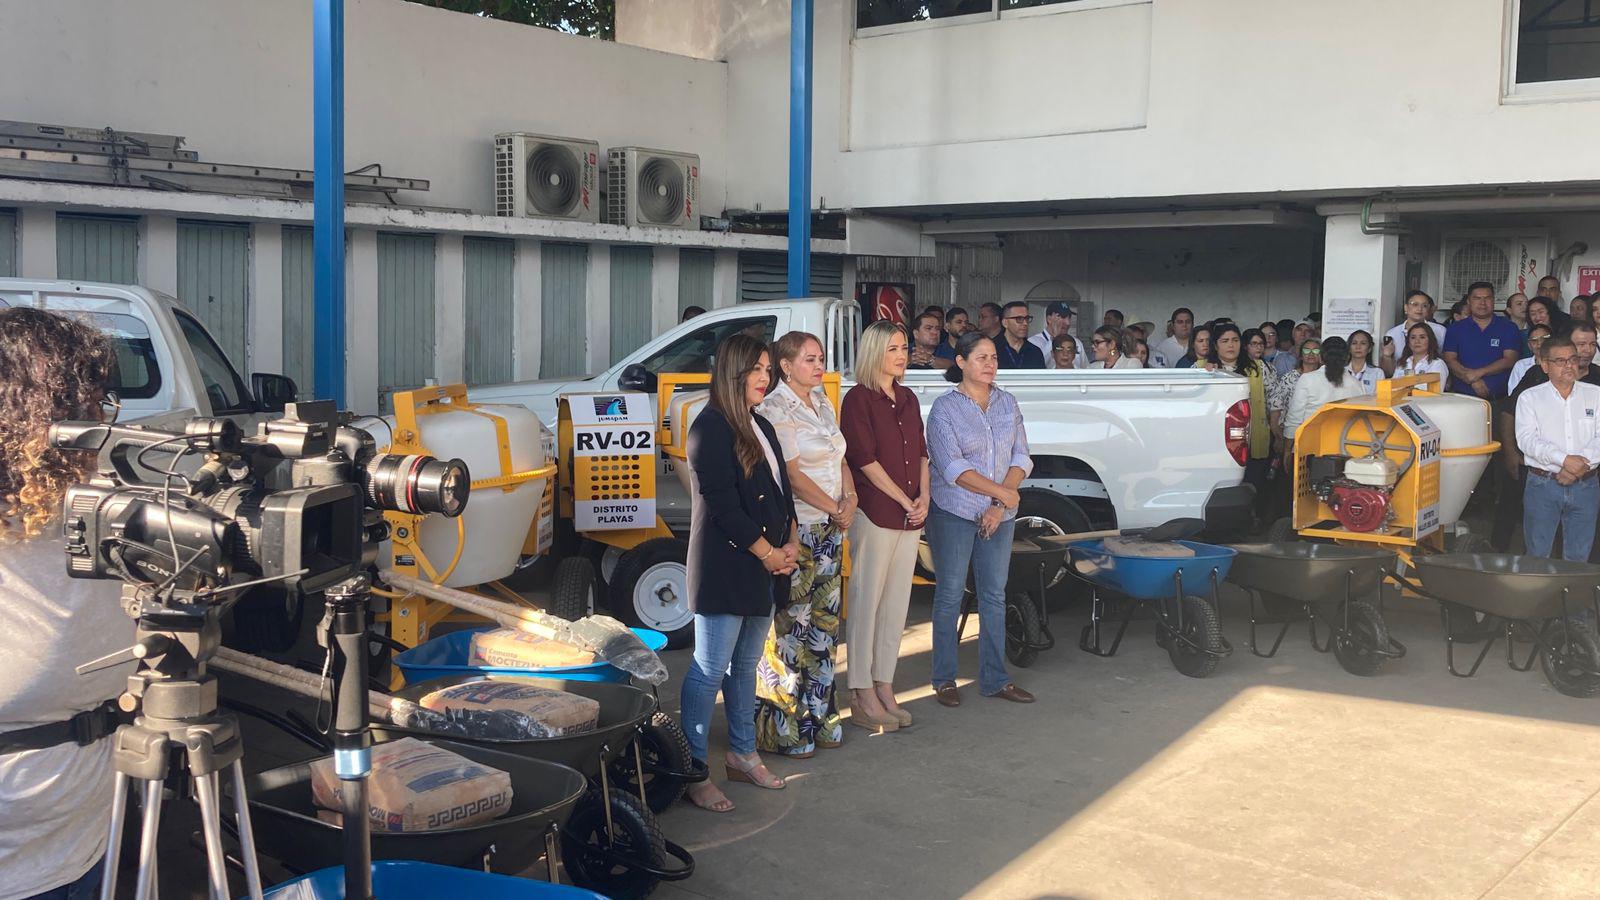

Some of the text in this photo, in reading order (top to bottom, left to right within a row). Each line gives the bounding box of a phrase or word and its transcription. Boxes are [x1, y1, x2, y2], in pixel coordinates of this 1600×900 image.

[577, 430, 651, 451] RV-02
[593, 505, 638, 514] DISTRITO
[597, 515, 634, 524] PLAYAS
